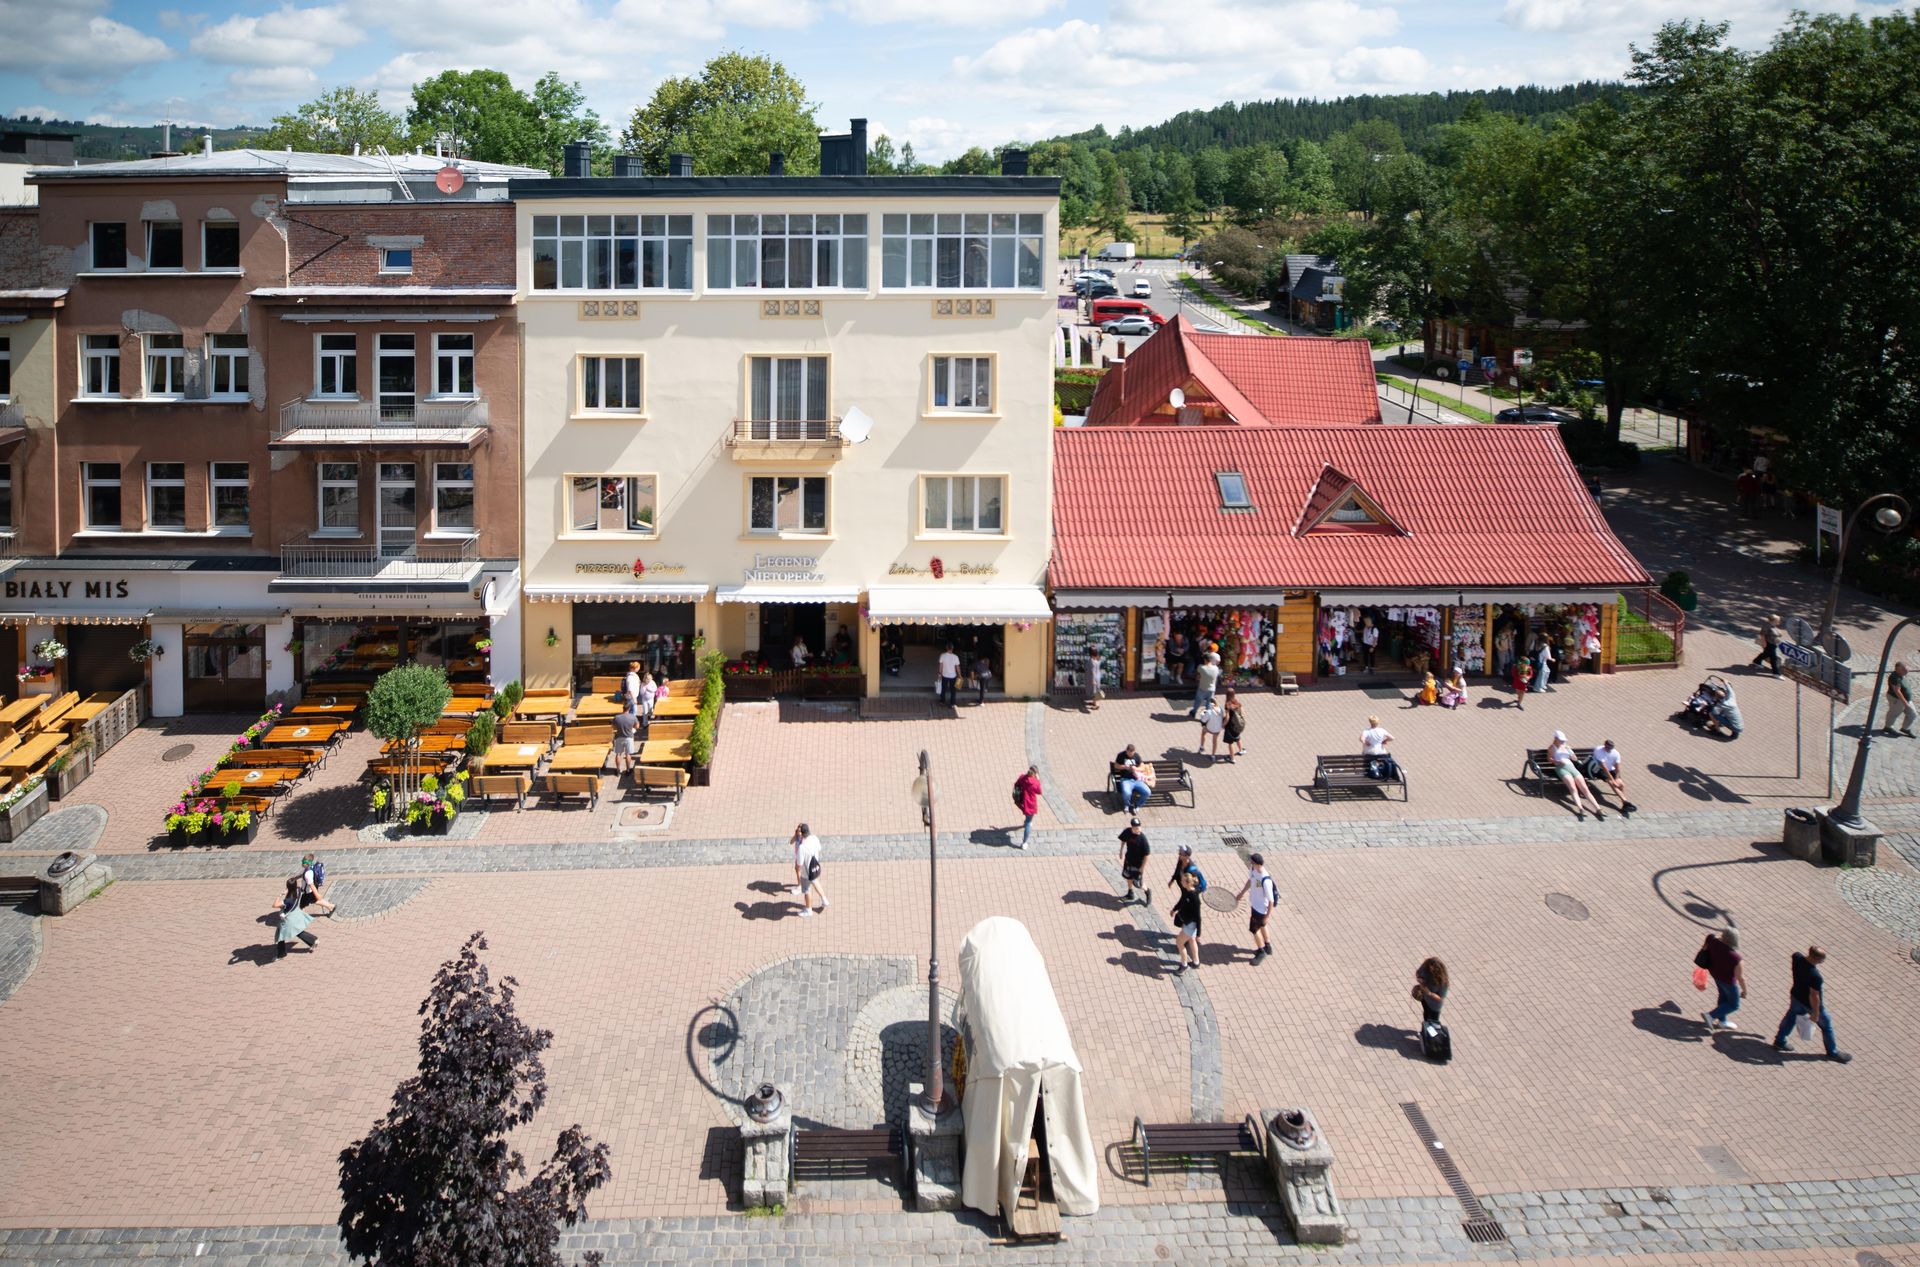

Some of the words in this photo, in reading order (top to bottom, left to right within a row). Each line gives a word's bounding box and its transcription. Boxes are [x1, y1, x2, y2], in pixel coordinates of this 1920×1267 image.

[575, 563, 630, 574] PIZZERIA
[755, 552, 821, 569] LEGENDA
[5, 581, 72, 598] BIAŁY
[85, 579, 129, 598] MIŚ
[1782, 643, 1809, 664] TAXI
